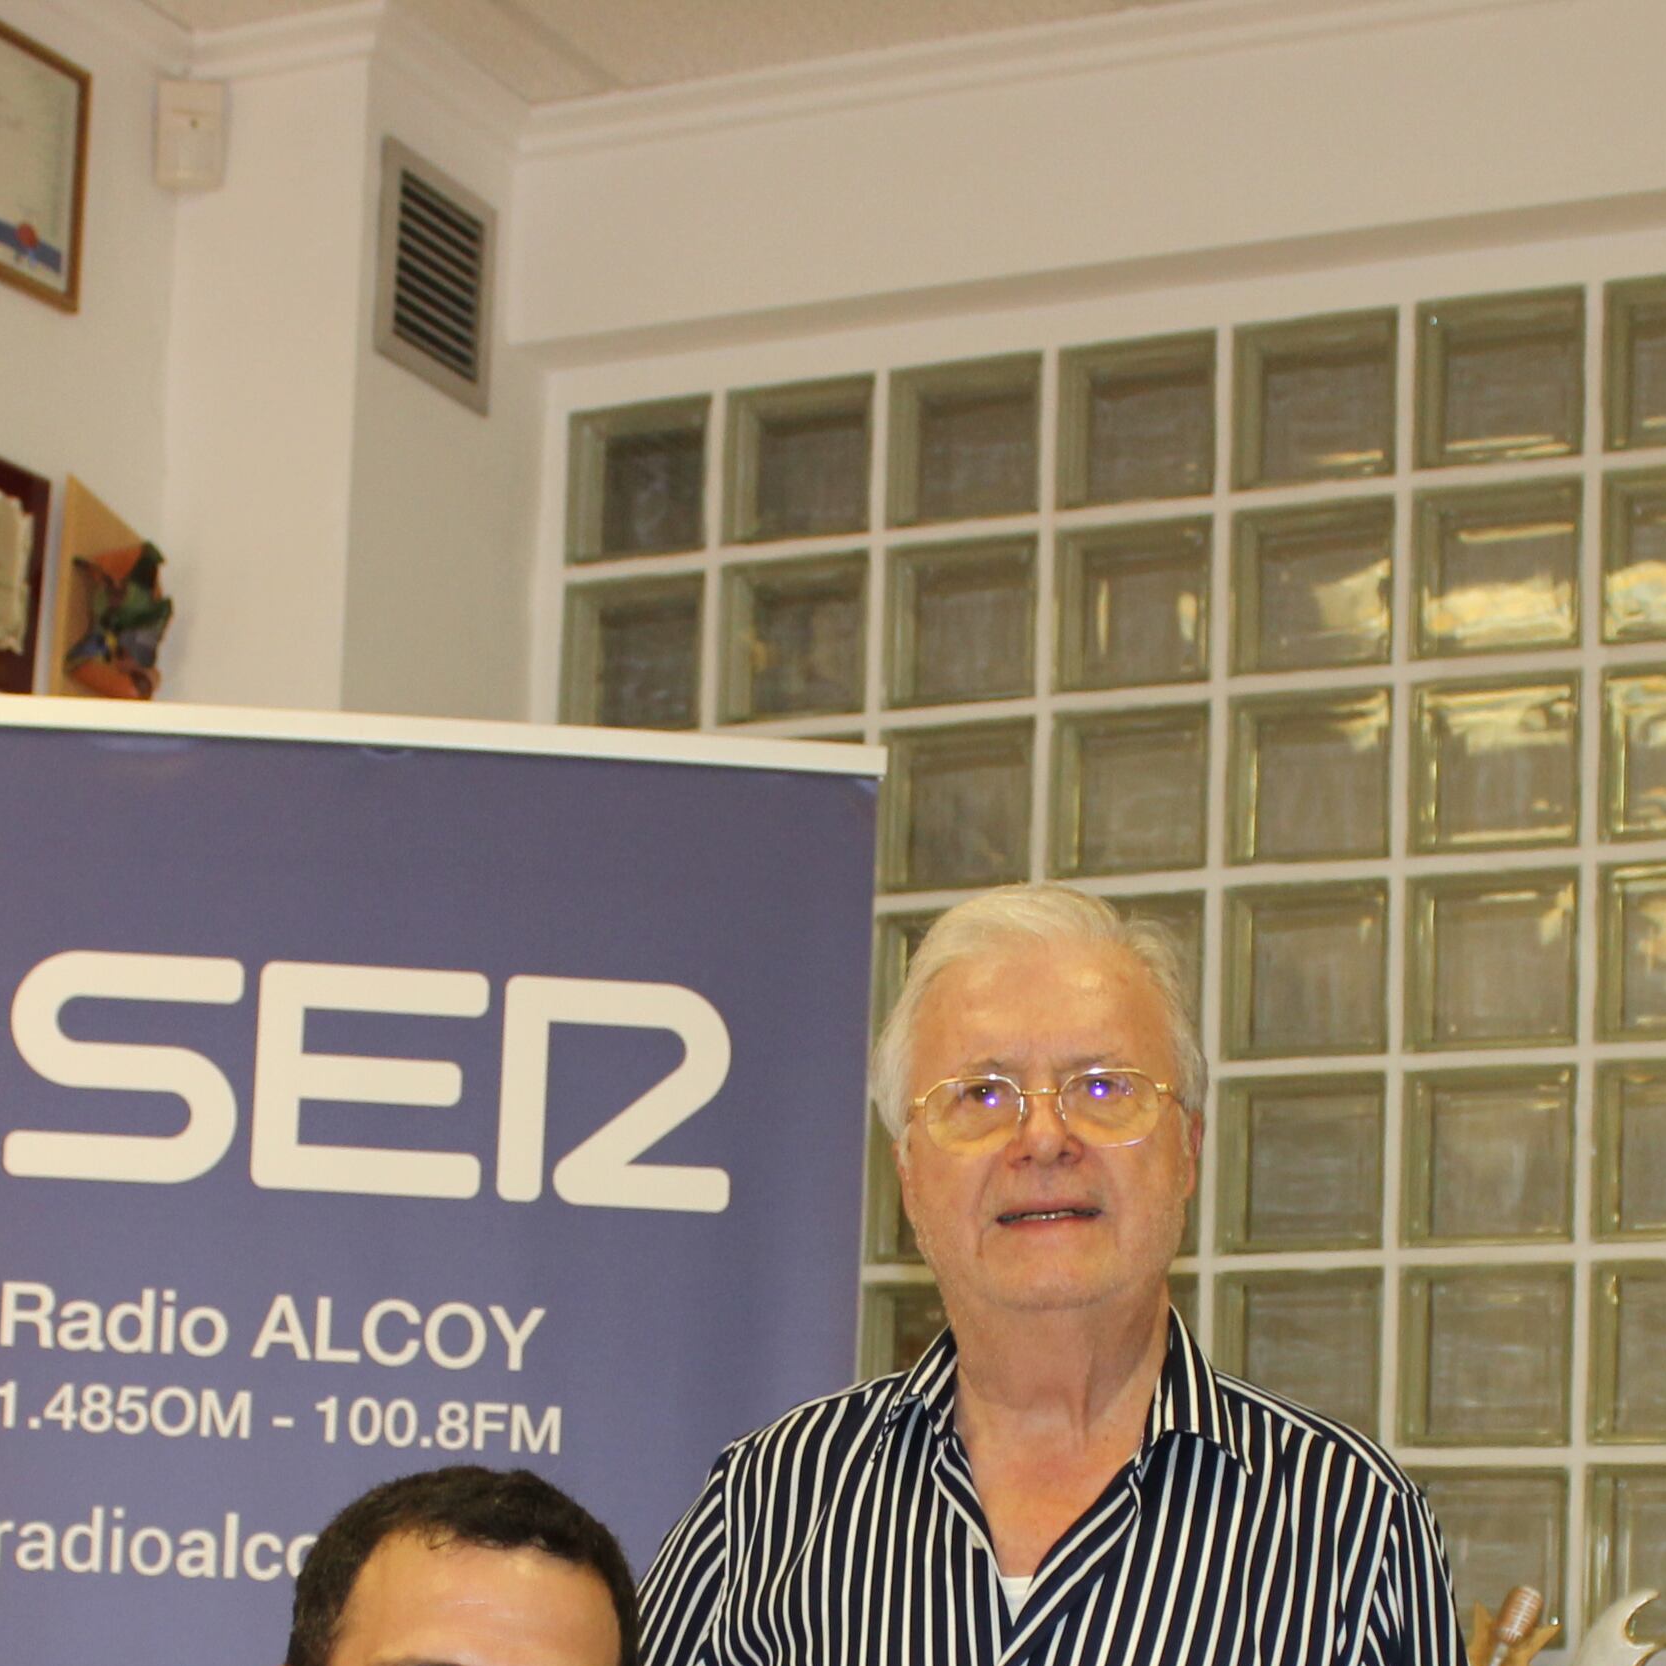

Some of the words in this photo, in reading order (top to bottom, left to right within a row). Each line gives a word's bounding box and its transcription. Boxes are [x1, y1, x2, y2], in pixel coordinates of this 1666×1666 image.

[1, 948, 732, 1214] SER
[0, 1280, 229, 1357] Radio
[251, 1292, 546, 1373] ALCOY
[315, 1394, 563, 1455] 100.8FM
